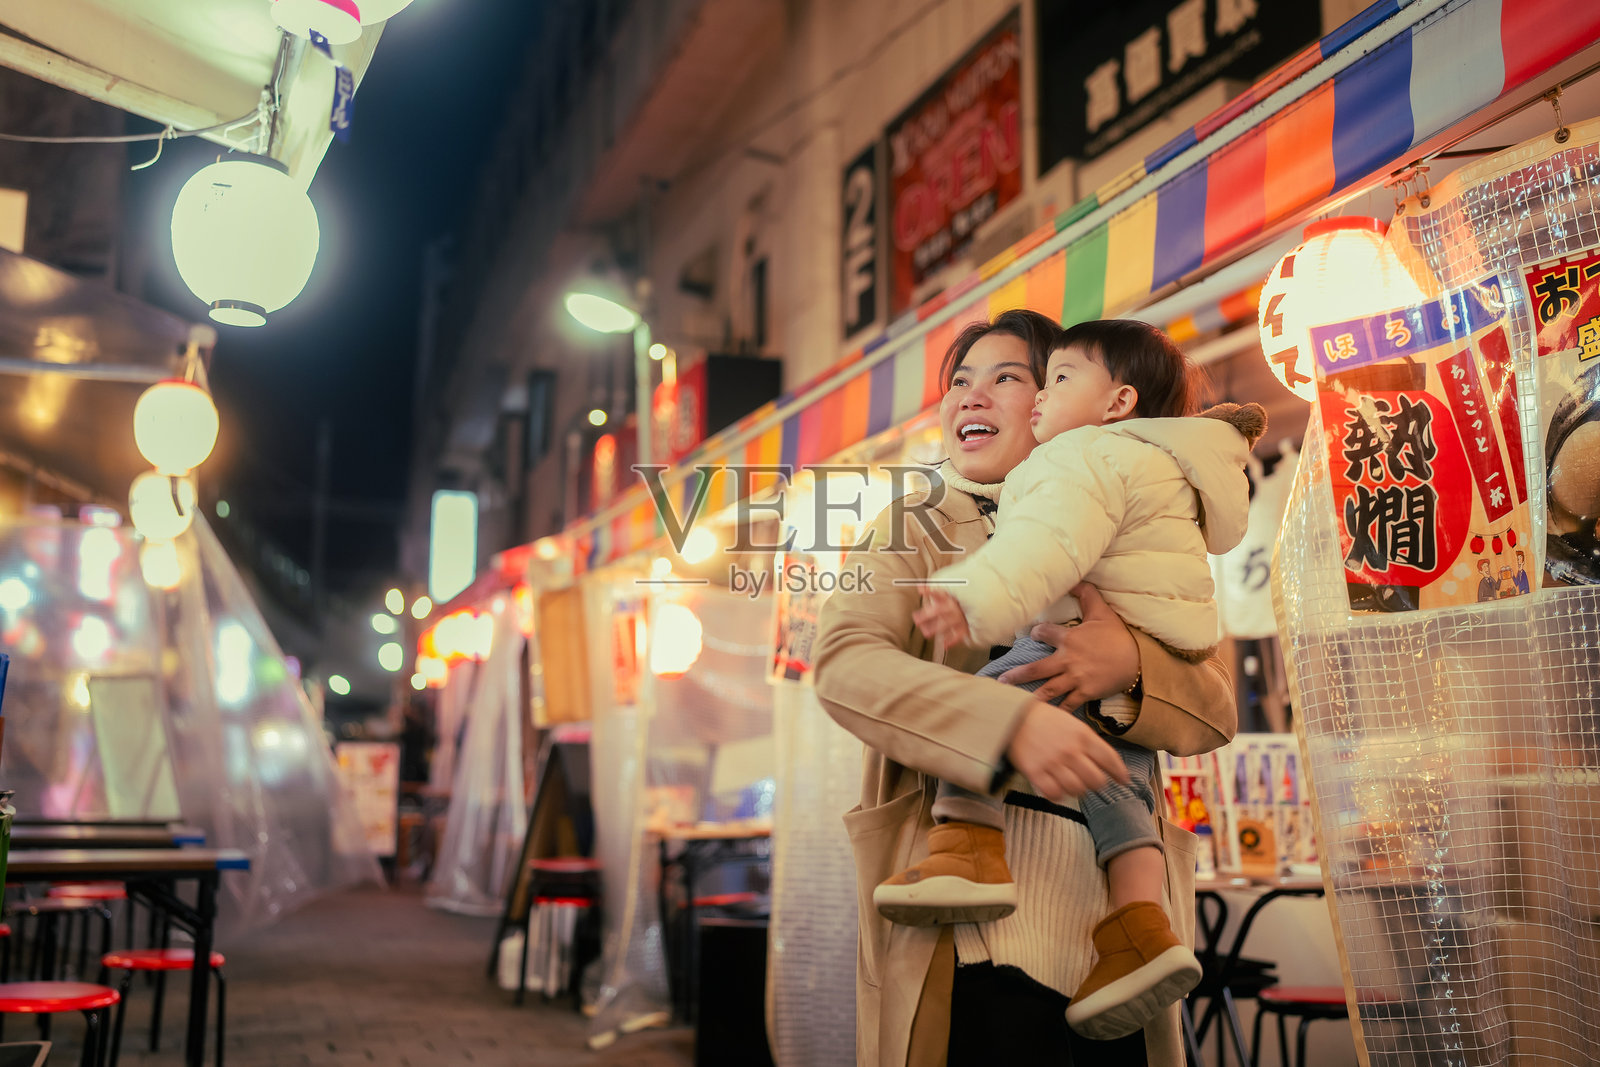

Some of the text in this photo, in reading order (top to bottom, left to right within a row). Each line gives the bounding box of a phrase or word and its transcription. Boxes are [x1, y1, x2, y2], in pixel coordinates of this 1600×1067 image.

[844, 165, 876, 327] 2F
[893, 102, 1020, 252] OPEN
[1450, 364, 1506, 509] ちょこっと 一杯
